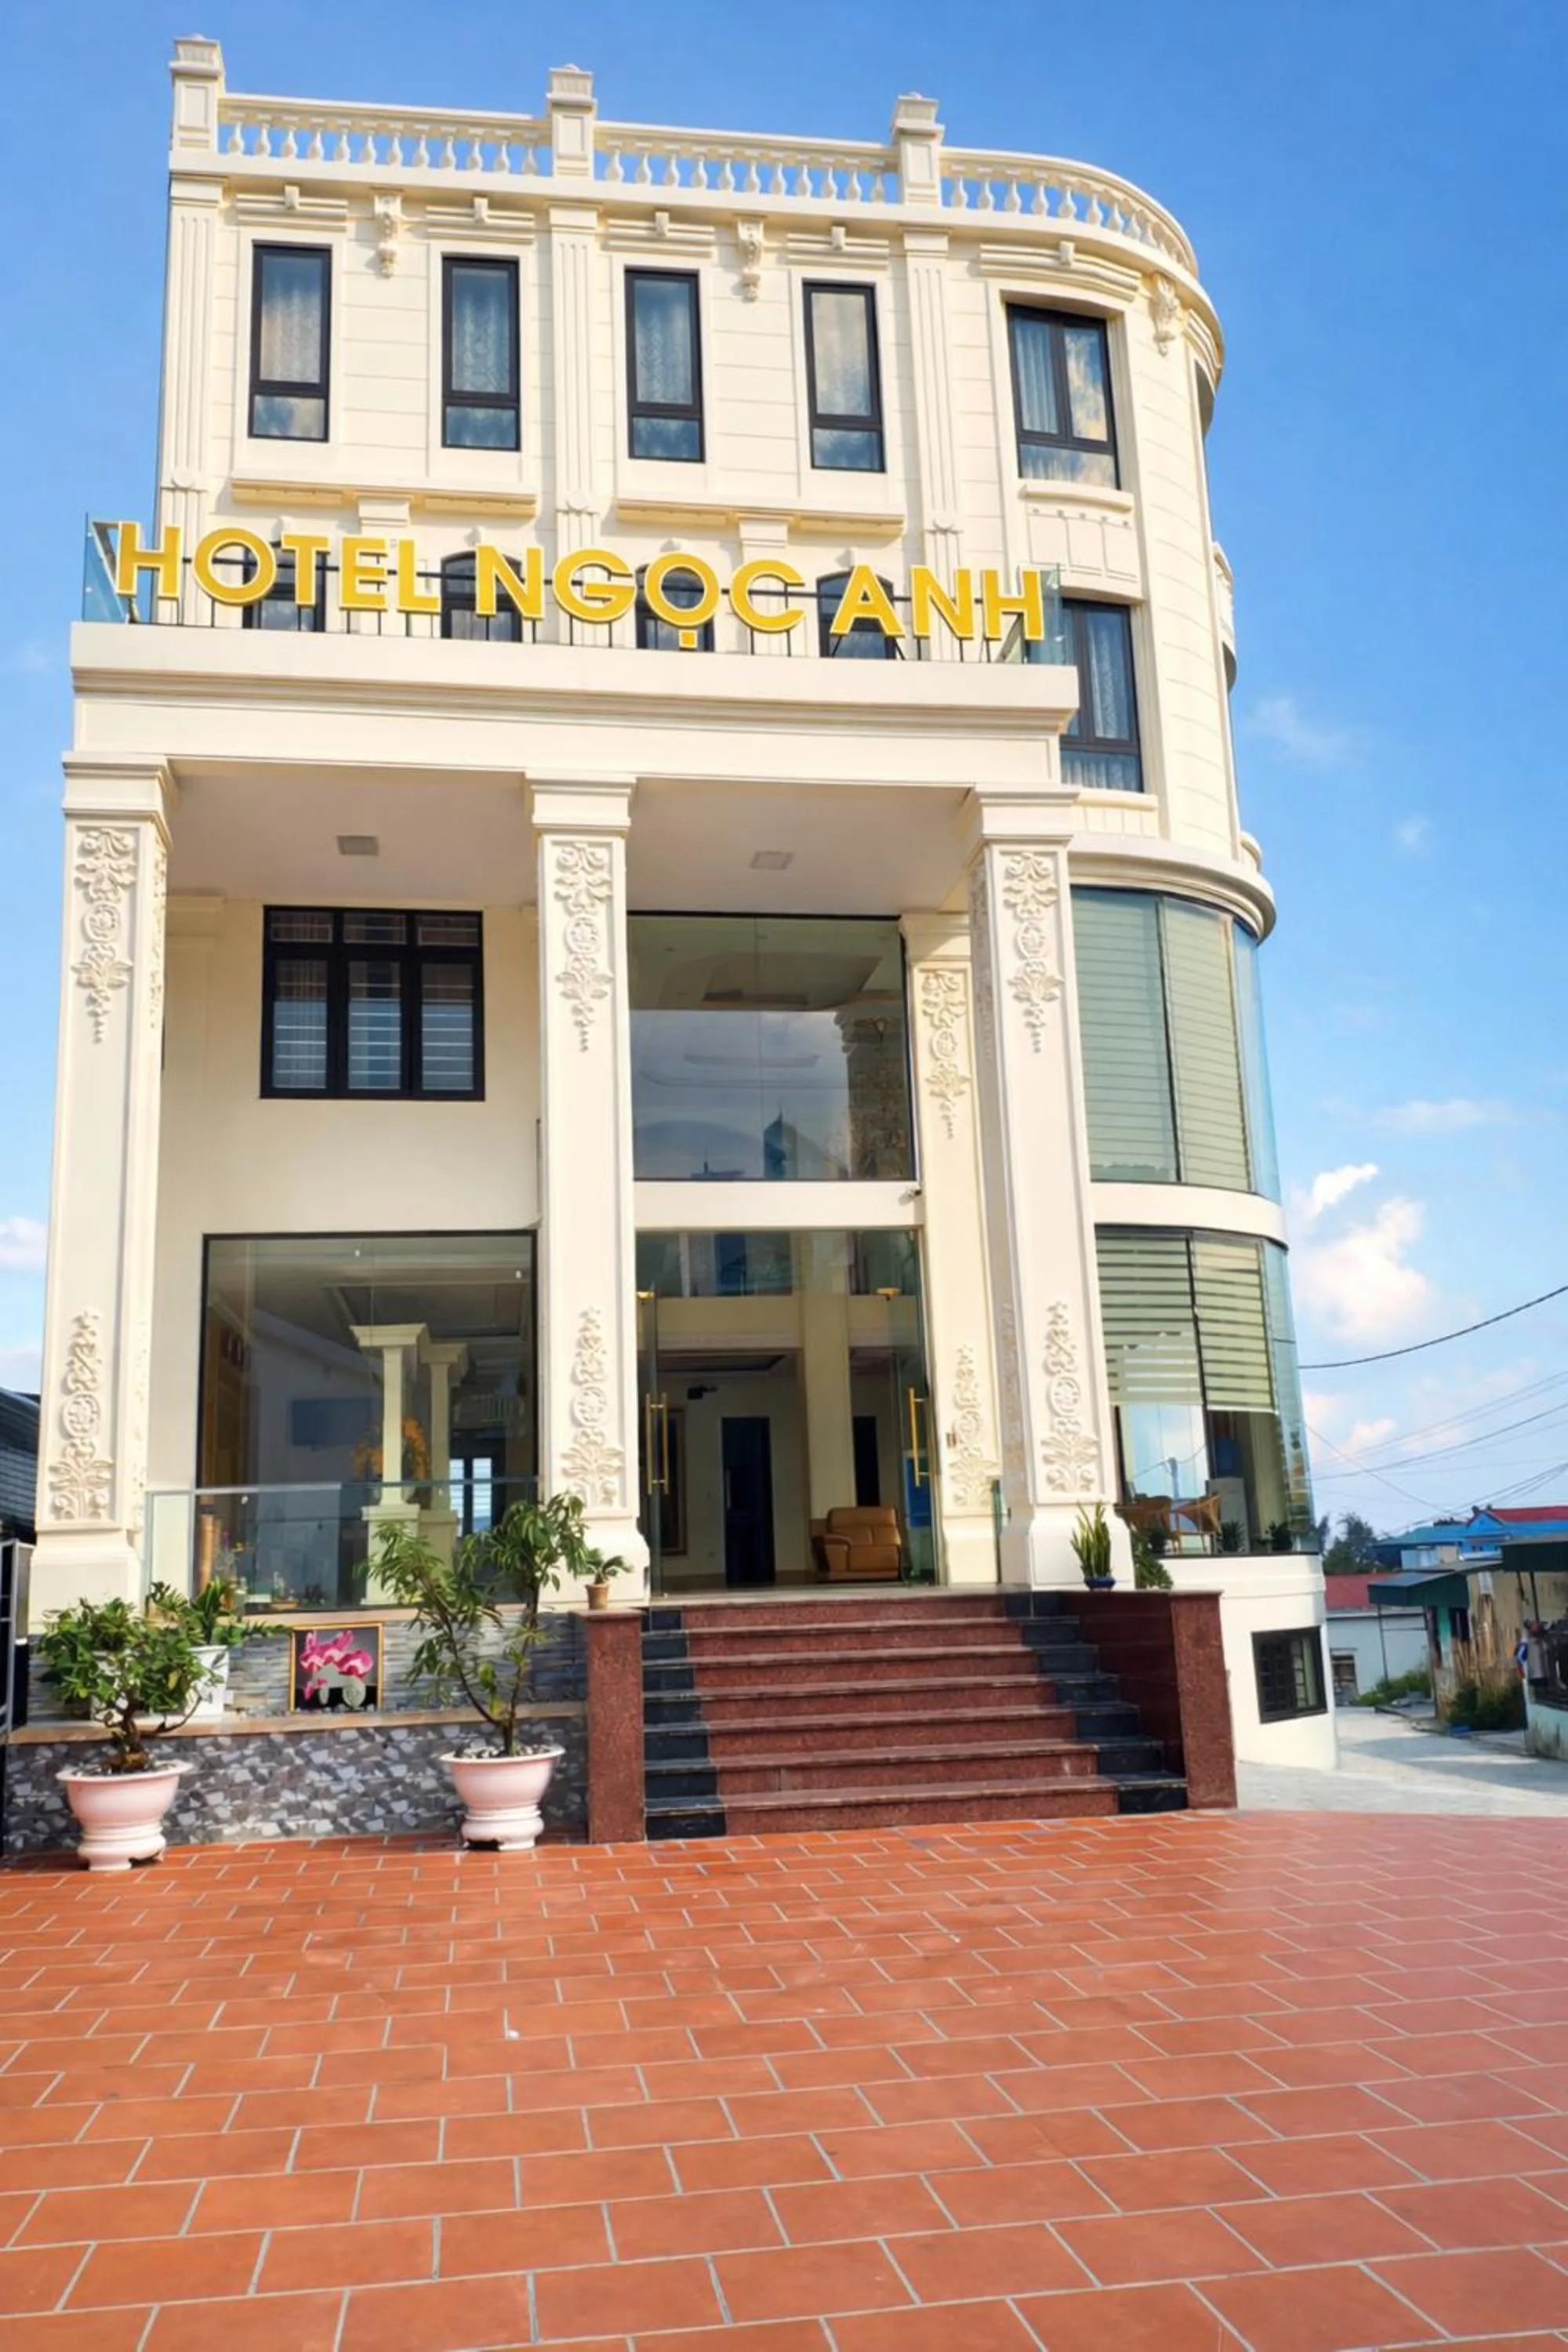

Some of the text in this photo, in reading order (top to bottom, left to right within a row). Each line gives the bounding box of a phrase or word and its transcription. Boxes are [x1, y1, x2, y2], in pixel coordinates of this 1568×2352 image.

[115, 521, 1045, 649] HOTEL NGỌC ANH
